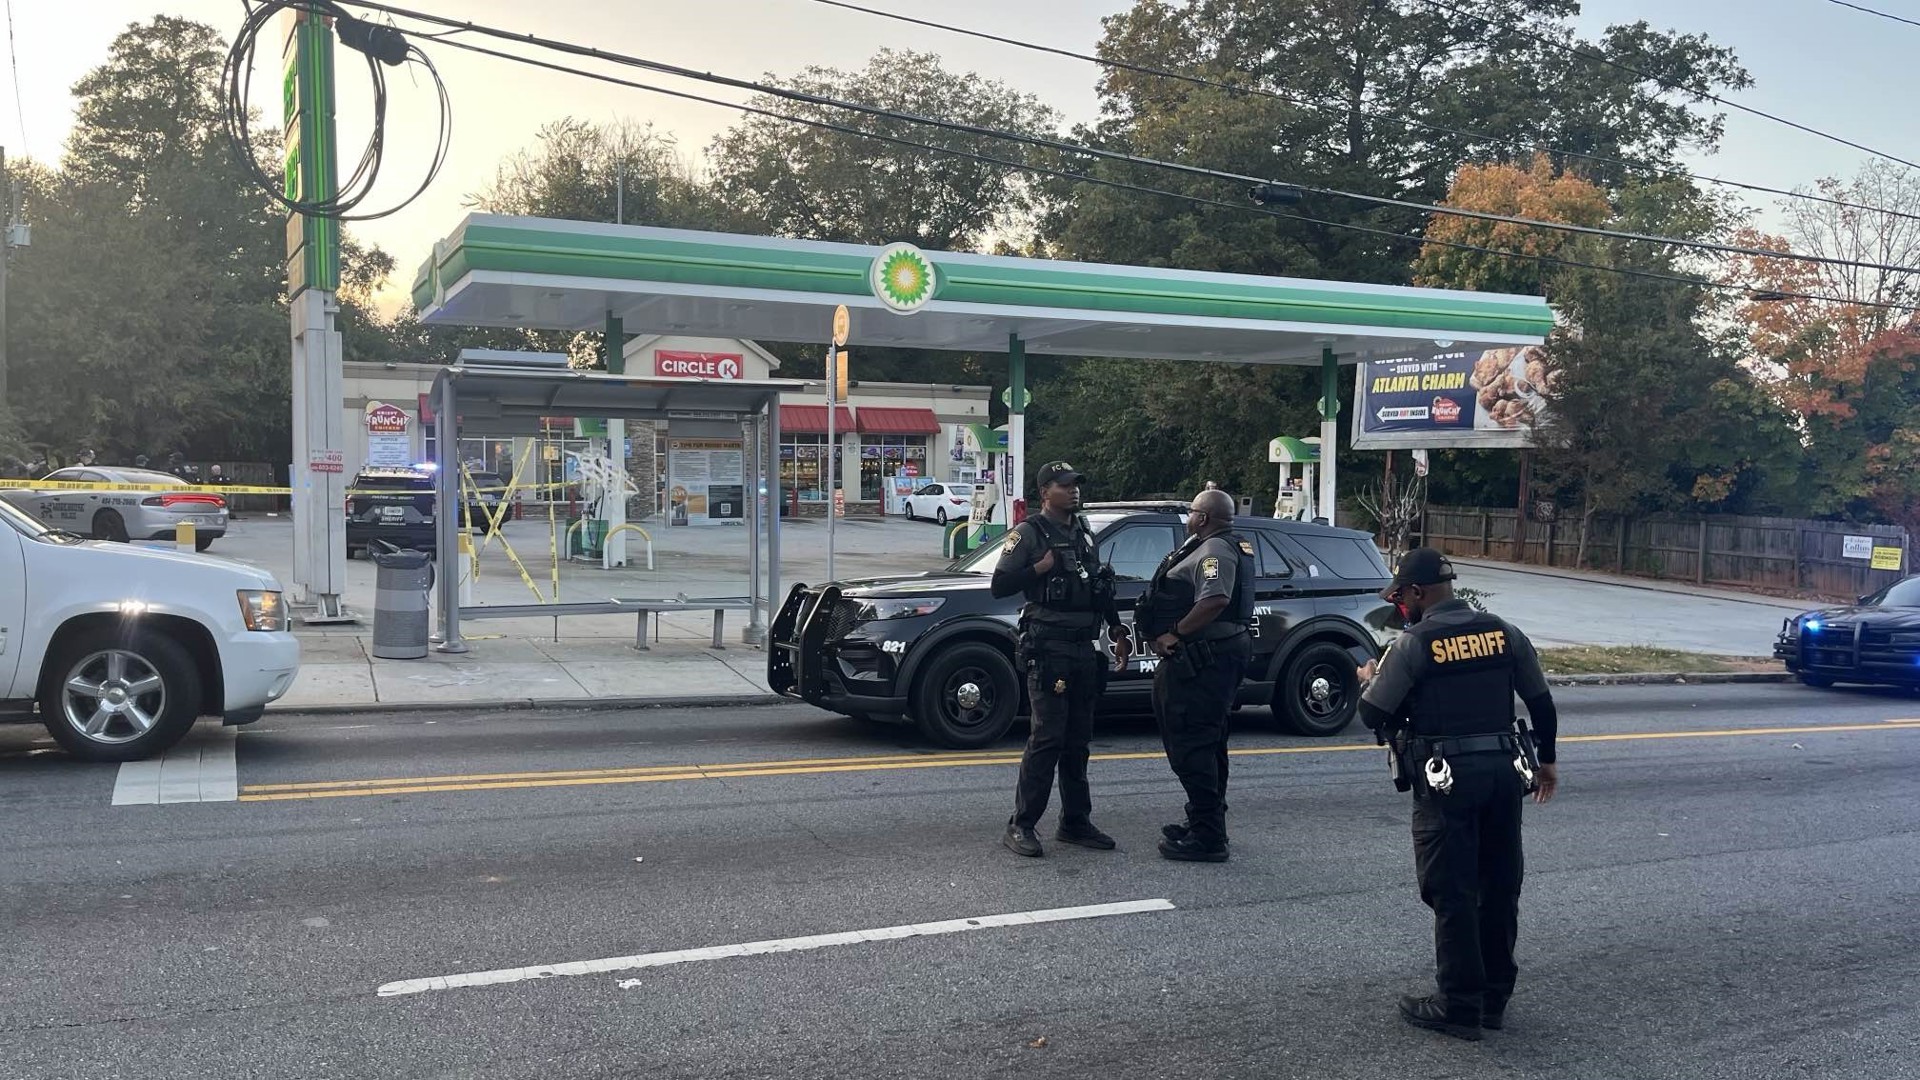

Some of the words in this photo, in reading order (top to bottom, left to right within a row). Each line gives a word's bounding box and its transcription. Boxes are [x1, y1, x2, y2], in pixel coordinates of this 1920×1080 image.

[662, 360, 715, 374] CIRCLE
[1396, 364, 1420, 373] SERVED
[1421, 362, 1438, 371] WITH
[1372, 376, 1419, 393] ATLANTA
[1421, 372, 1466, 391] CHARM
[365, 414, 412, 426] KRUNCHY
[882, 640, 906, 653] 821
[1431, 630, 1506, 664] SHERIFF
